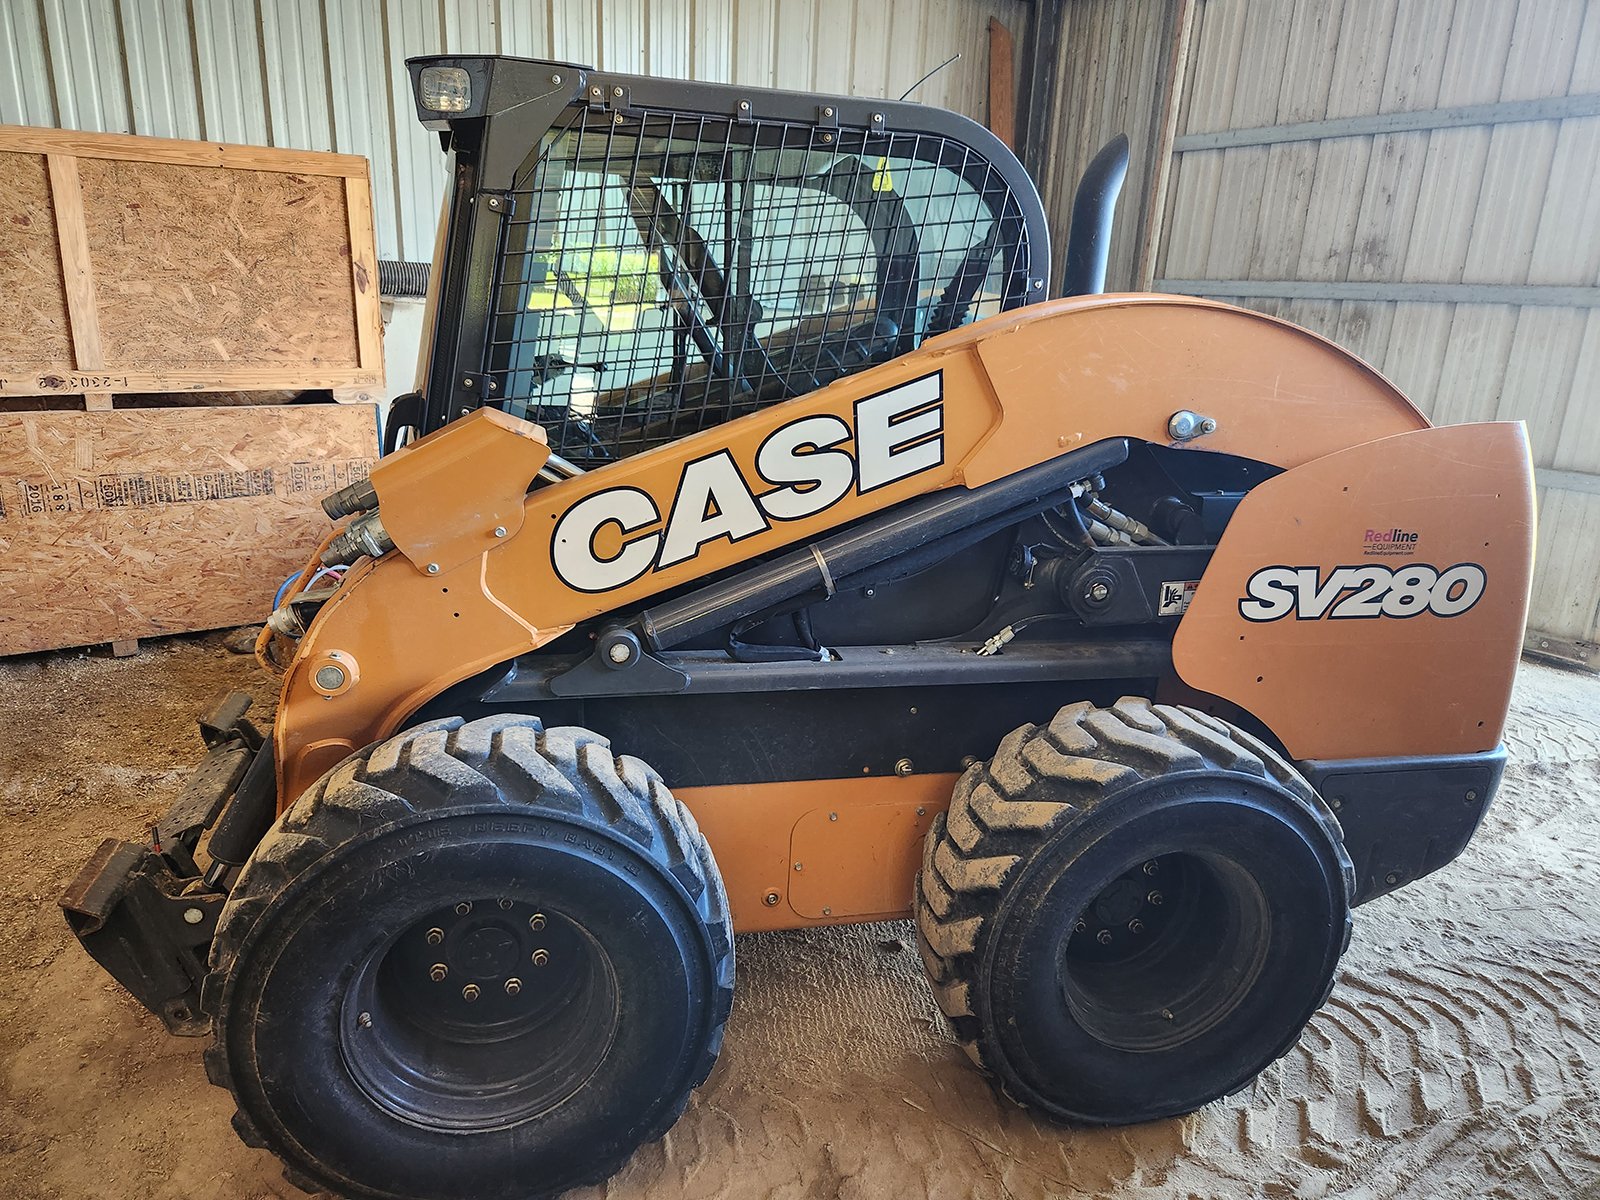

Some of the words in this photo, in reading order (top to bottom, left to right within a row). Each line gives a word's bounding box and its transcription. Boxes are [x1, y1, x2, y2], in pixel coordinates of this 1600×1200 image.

[550, 370, 944, 593] CASE
[27, 485, 42, 512] 2016
[1364, 528, 1419, 543] Redline
[1371, 543, 1417, 551] EQUIPMENT
[1238, 562, 1488, 623] SV280
[564, 831, 617, 860] BABY
